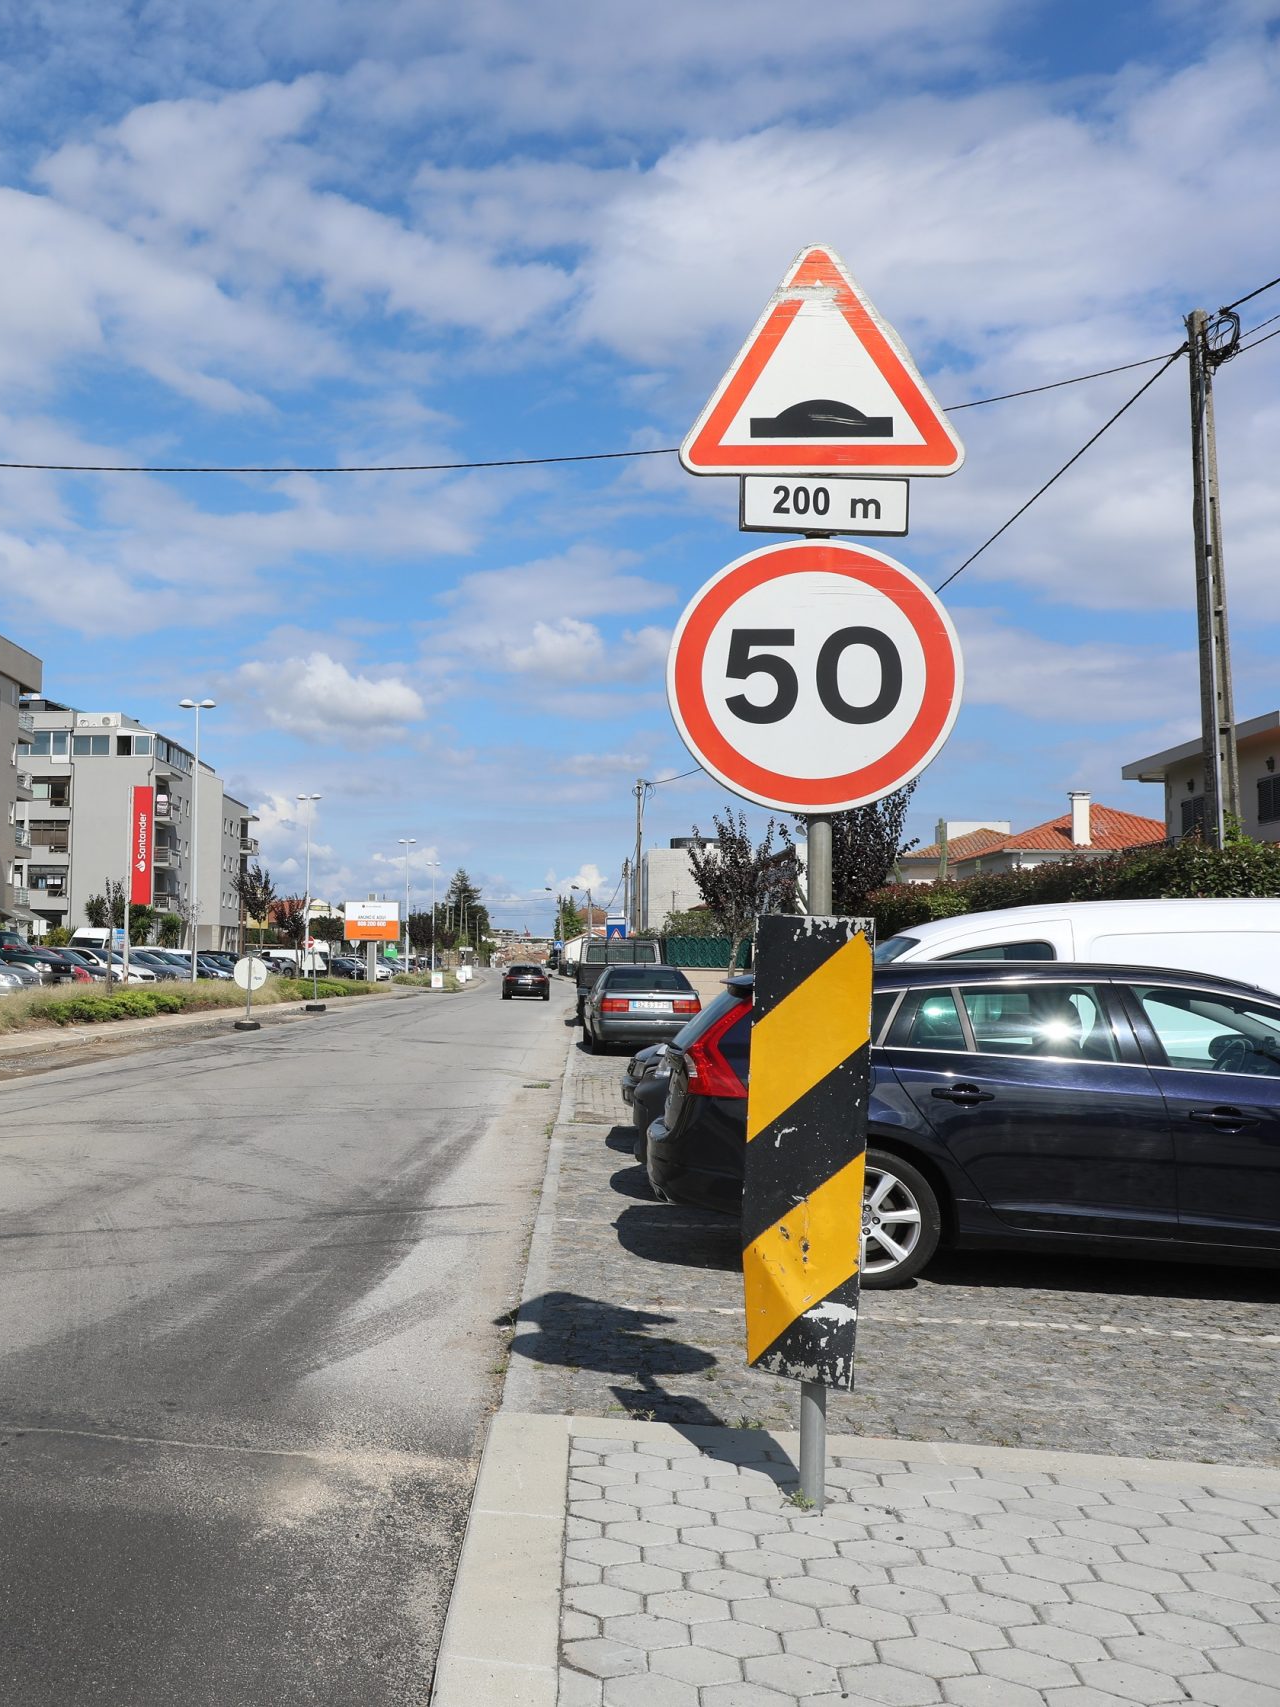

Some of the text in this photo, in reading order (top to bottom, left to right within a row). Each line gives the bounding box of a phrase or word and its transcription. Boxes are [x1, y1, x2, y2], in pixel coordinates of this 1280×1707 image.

[773, 485, 881, 520] 200 m
[724, 626, 903, 725] 50
[137, 812, 147, 860] Santander
